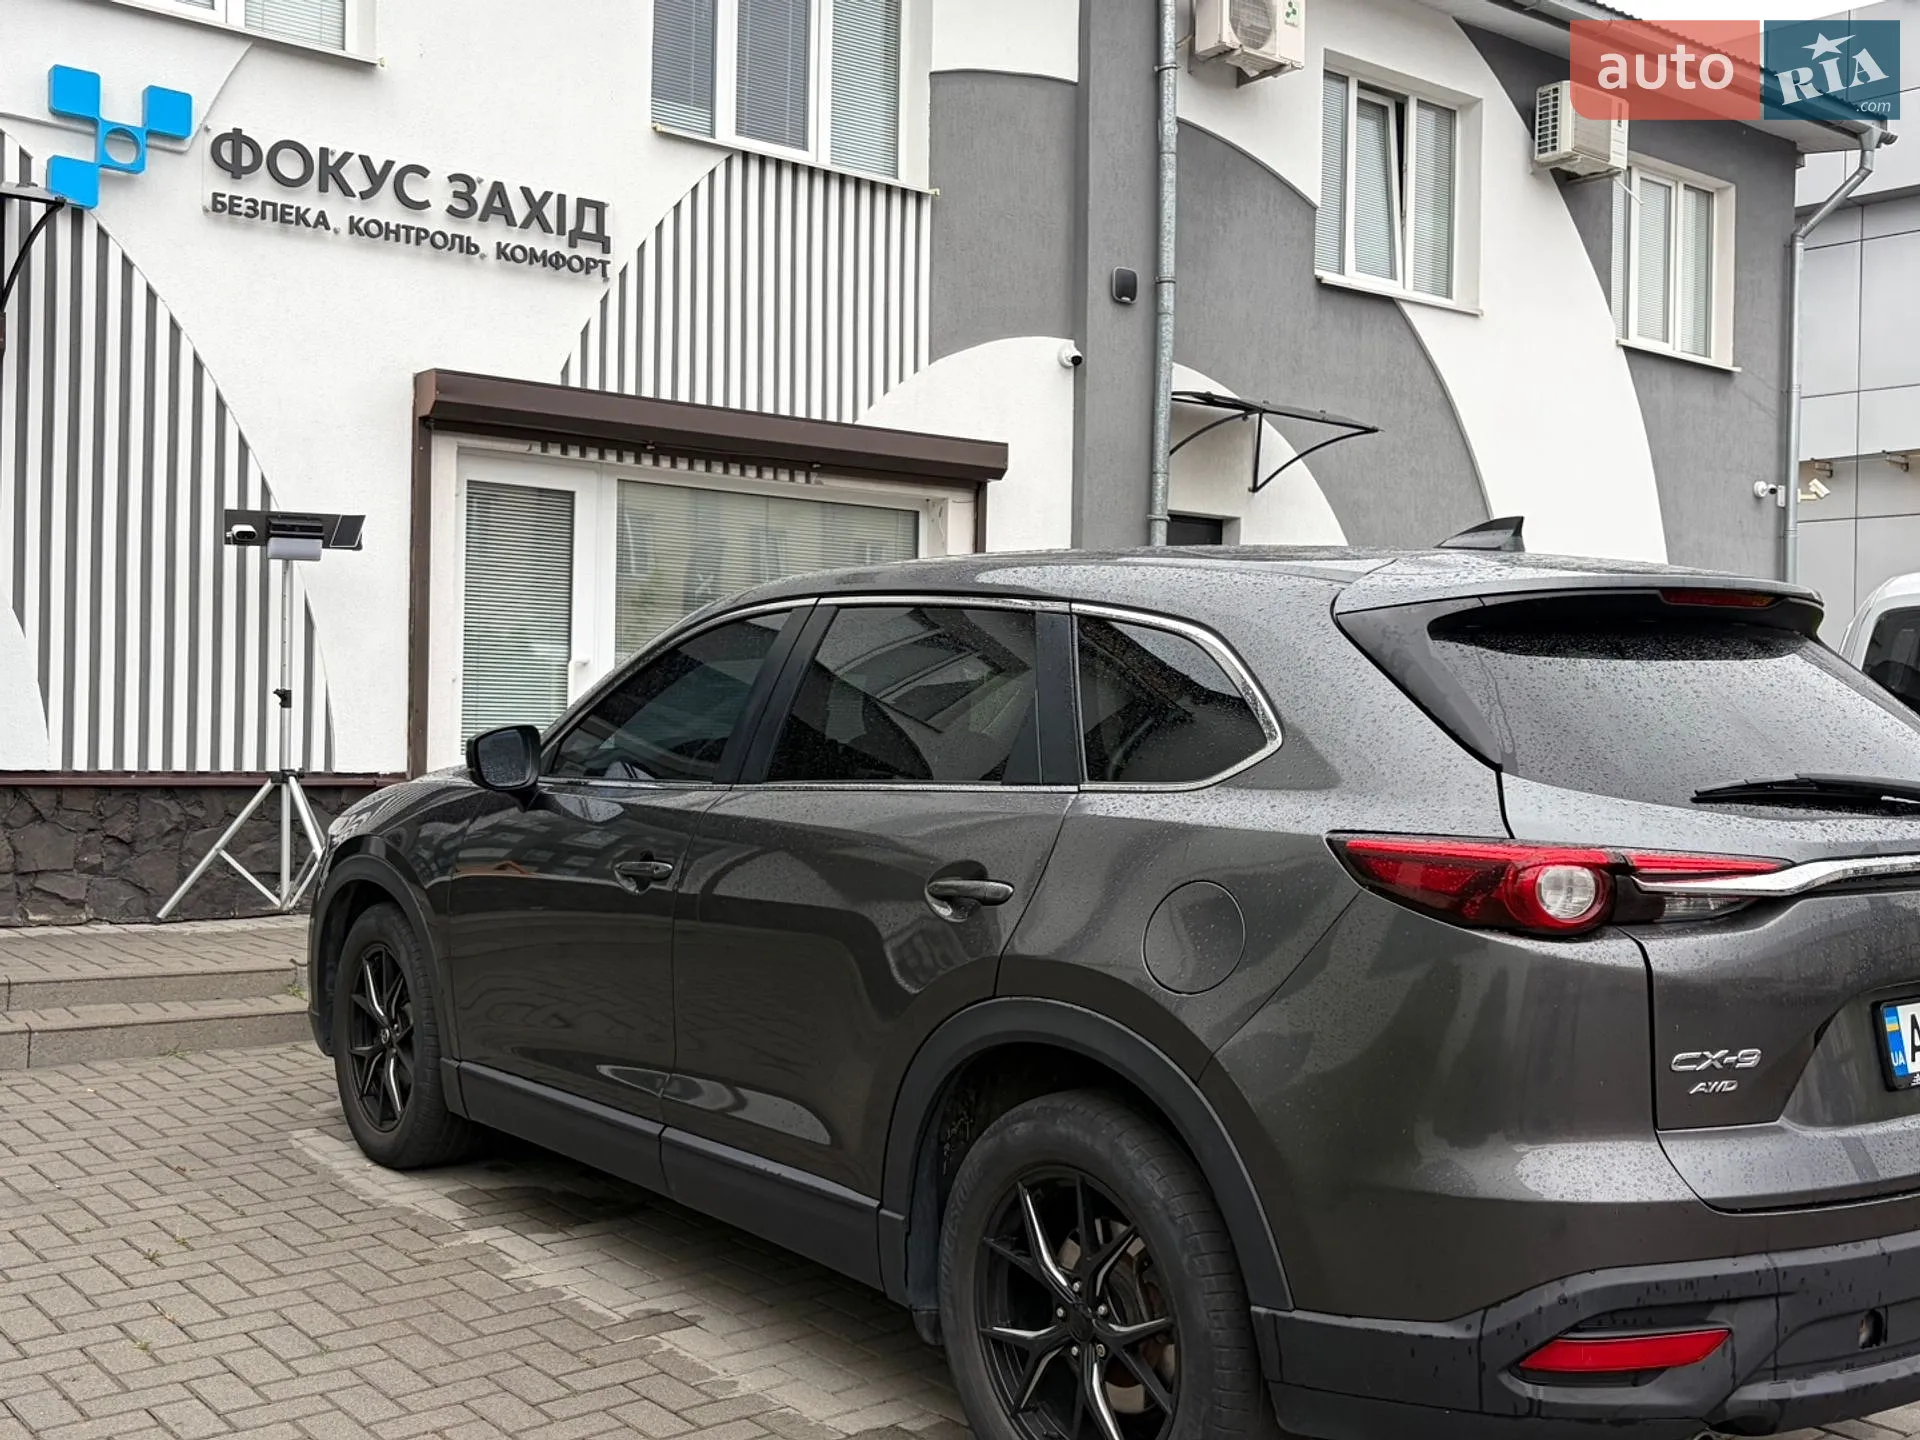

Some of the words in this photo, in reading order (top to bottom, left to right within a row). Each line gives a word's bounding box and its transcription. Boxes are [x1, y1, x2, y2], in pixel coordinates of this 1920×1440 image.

[210, 127, 431, 211] ФОКУС
[445, 173, 611, 254] ЗАХІД
[496, 241, 611, 278] КОМФОРТ
[1670, 1048, 1762, 1072] CX-9
[1891, 1050, 1906, 1067] UA
[1688, 1080, 1739, 1095] AWD
